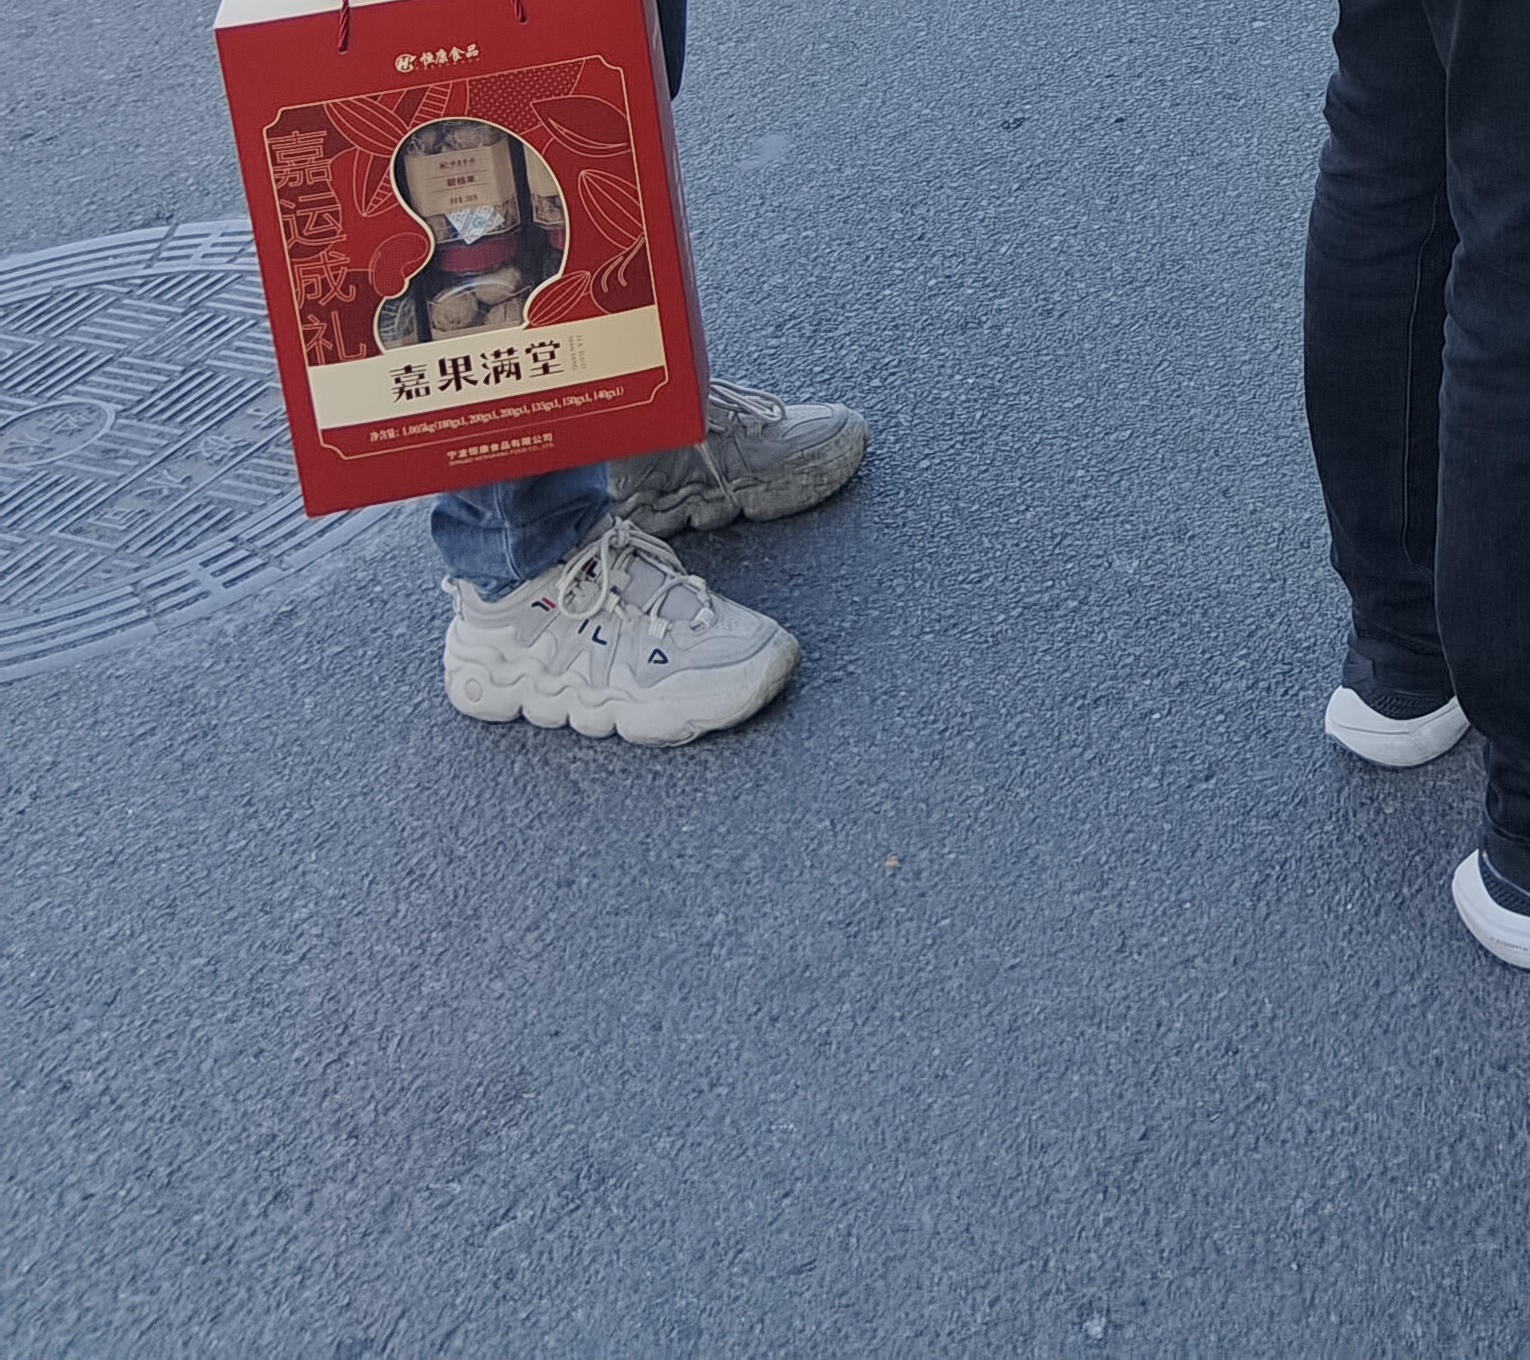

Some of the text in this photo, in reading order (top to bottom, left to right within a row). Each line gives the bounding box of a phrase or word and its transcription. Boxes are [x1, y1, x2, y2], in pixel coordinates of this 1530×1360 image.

[419, 43, 480, 70] 恒康食品
[268, 130, 367, 364] 嘉运成礼
[388, 340, 565, 403] 嘉果满堂
[446, 432, 553, 460] 宁波恒康食品有限公司
